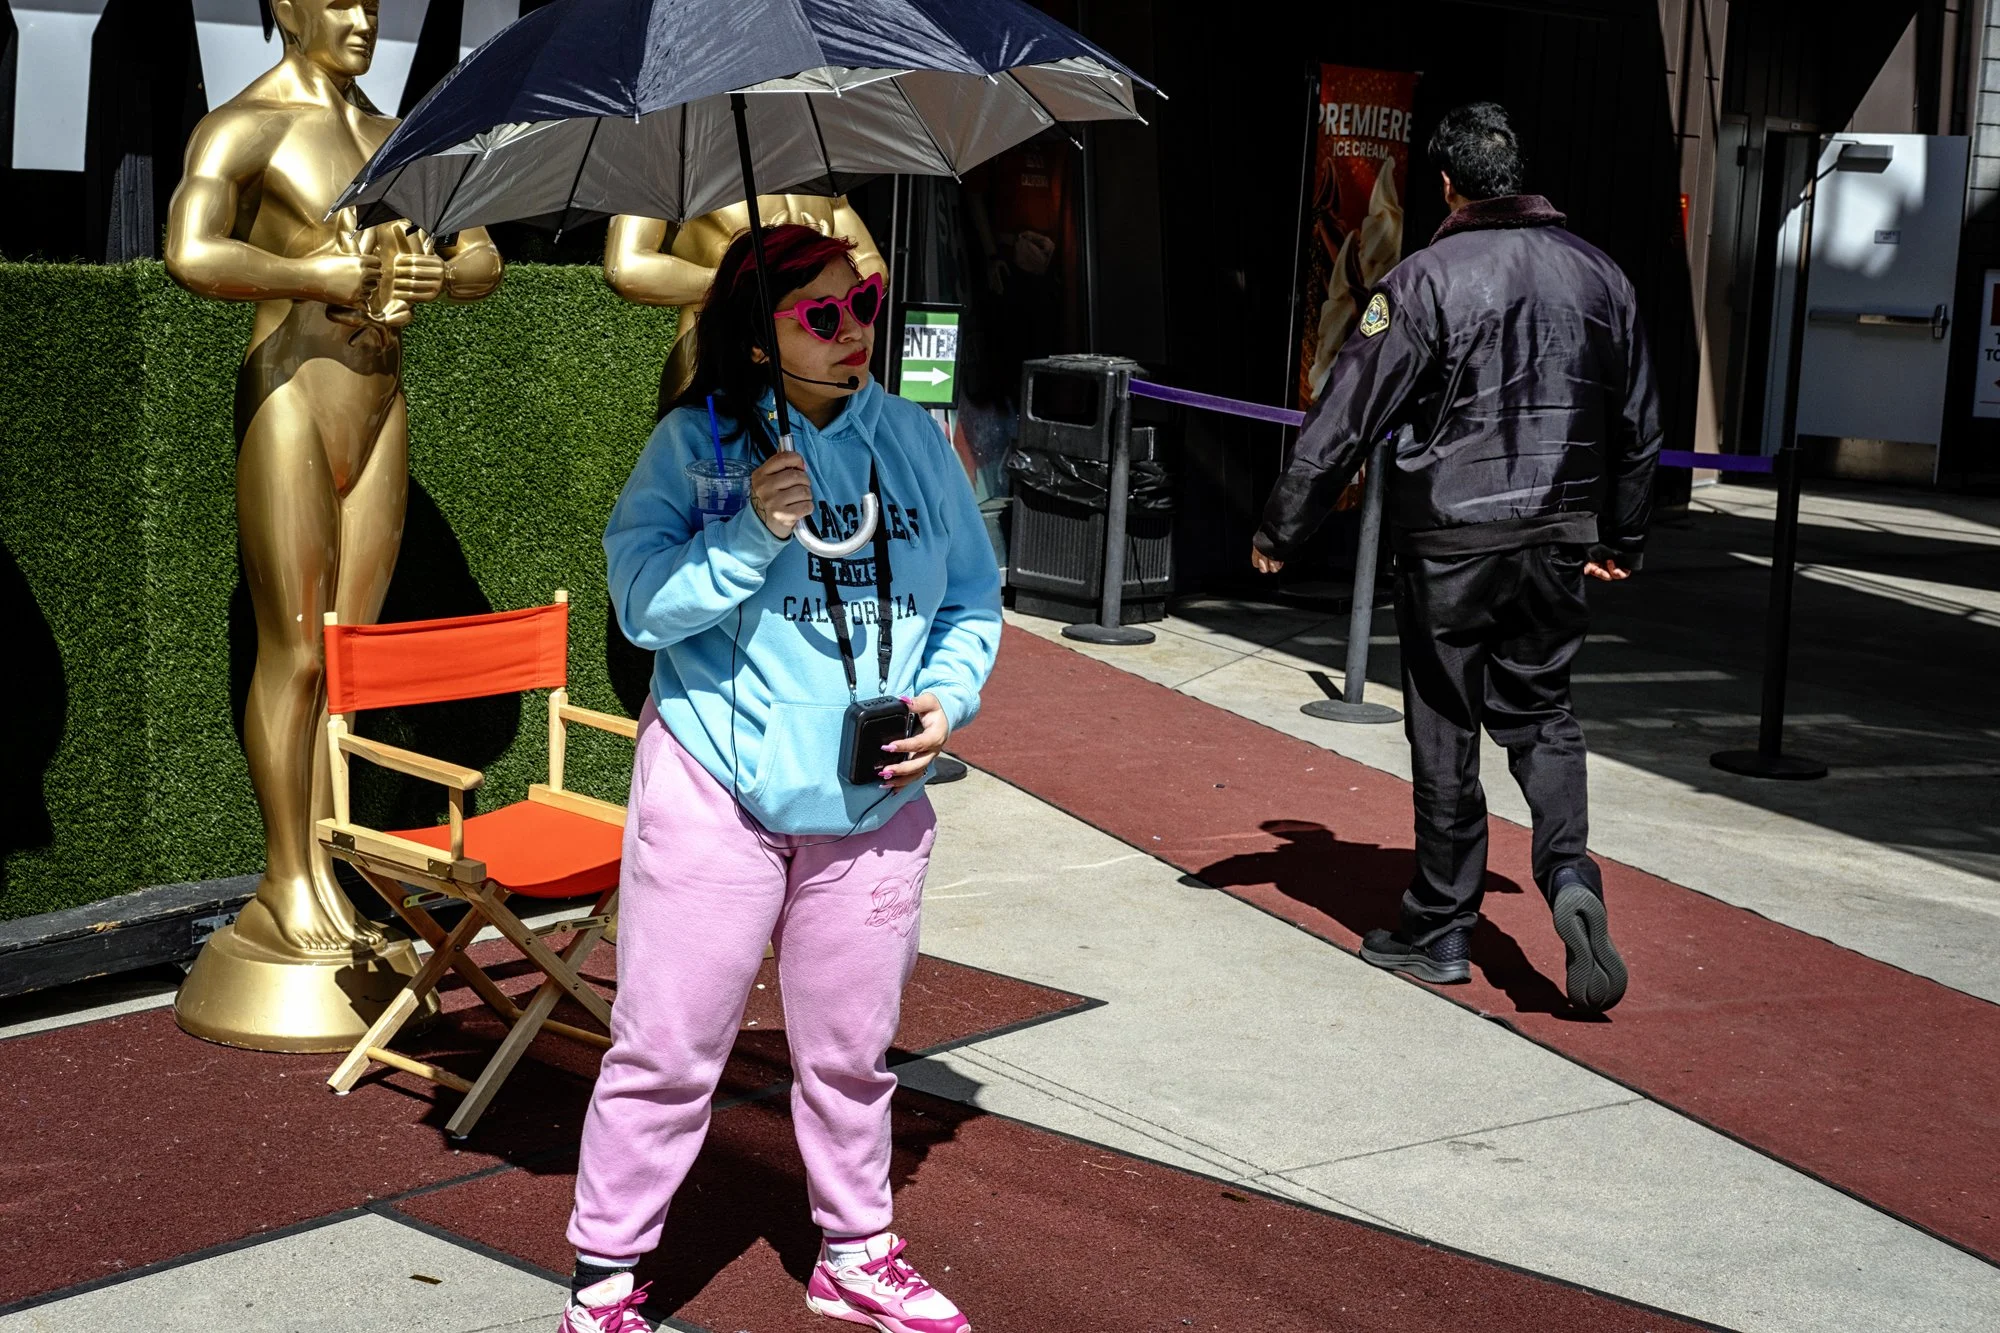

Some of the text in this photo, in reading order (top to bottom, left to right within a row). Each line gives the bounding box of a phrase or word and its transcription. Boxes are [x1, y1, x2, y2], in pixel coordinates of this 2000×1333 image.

[1333, 141, 1389, 160] ICE CREAM
[784, 593, 918, 626] CALORIA
